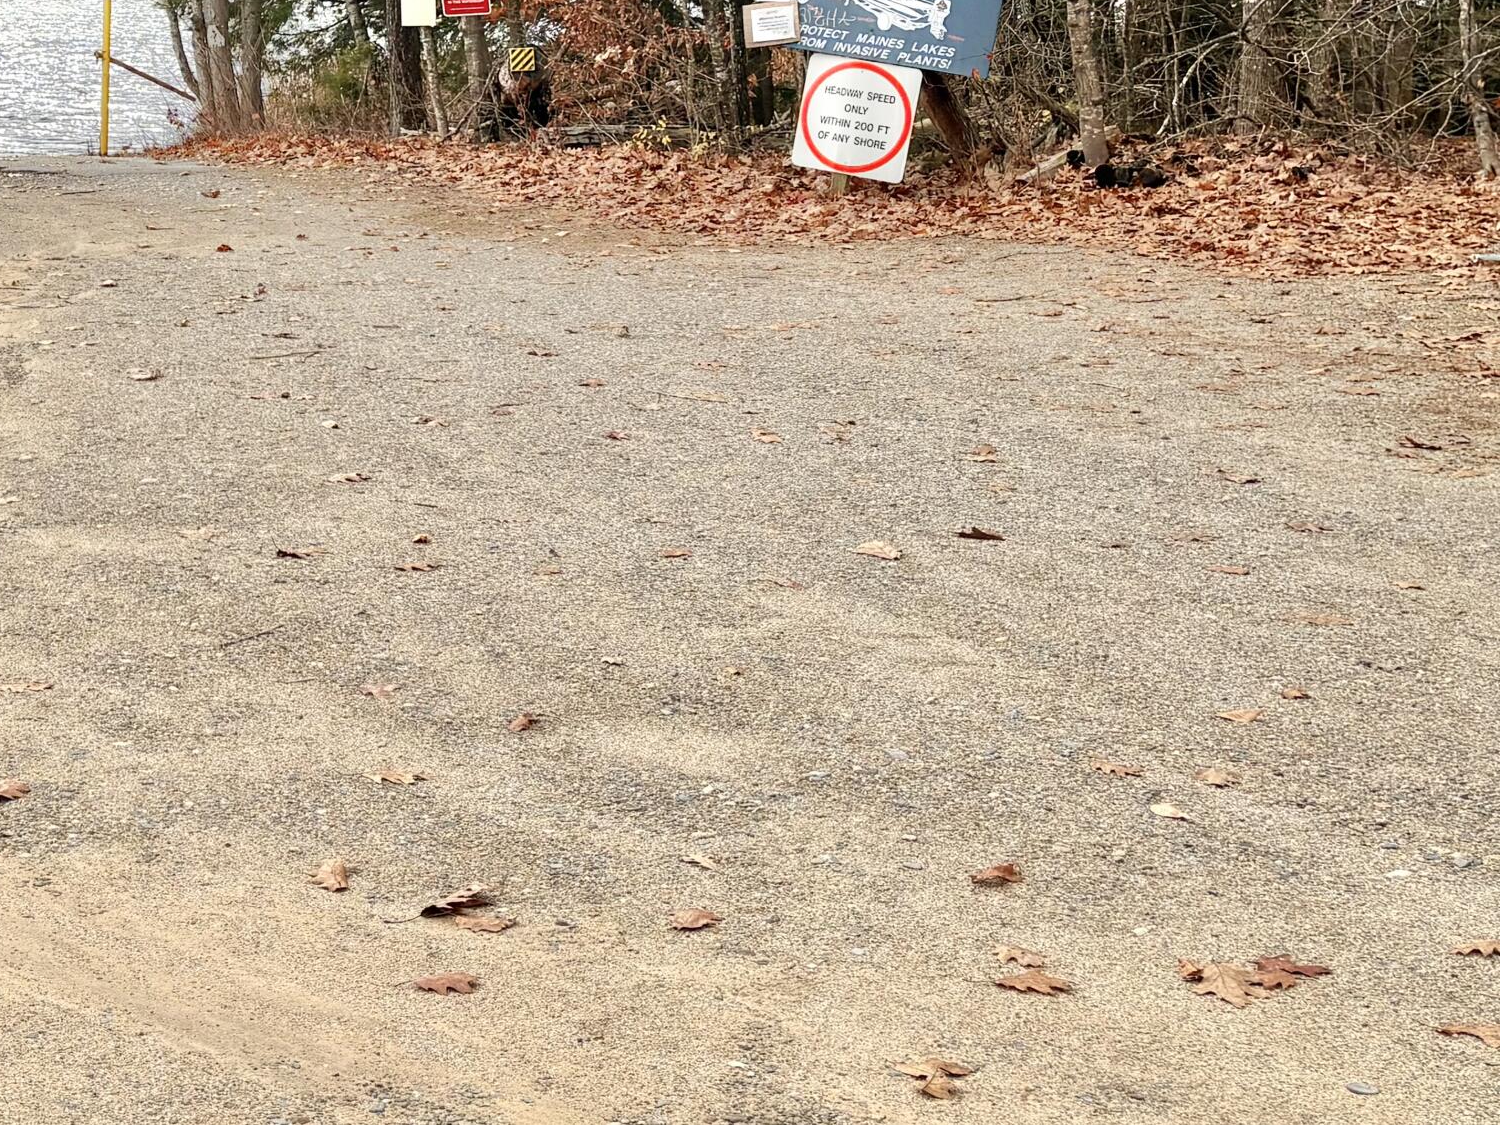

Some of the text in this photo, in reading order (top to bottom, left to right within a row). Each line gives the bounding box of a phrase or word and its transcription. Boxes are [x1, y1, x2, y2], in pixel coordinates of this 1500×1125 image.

[800, 24, 956, 57] ROTECT MAINES LAKES
[798, 35, 952, 70] ROM INVASIVE PLANTS!
[824, 85, 896, 105] HEADWAY SPEED
[844, 103, 869, 115] ONLY
[820, 115, 891, 135] WITHIN 200 FT
[817, 130, 887, 150] OF ANY SHORE
